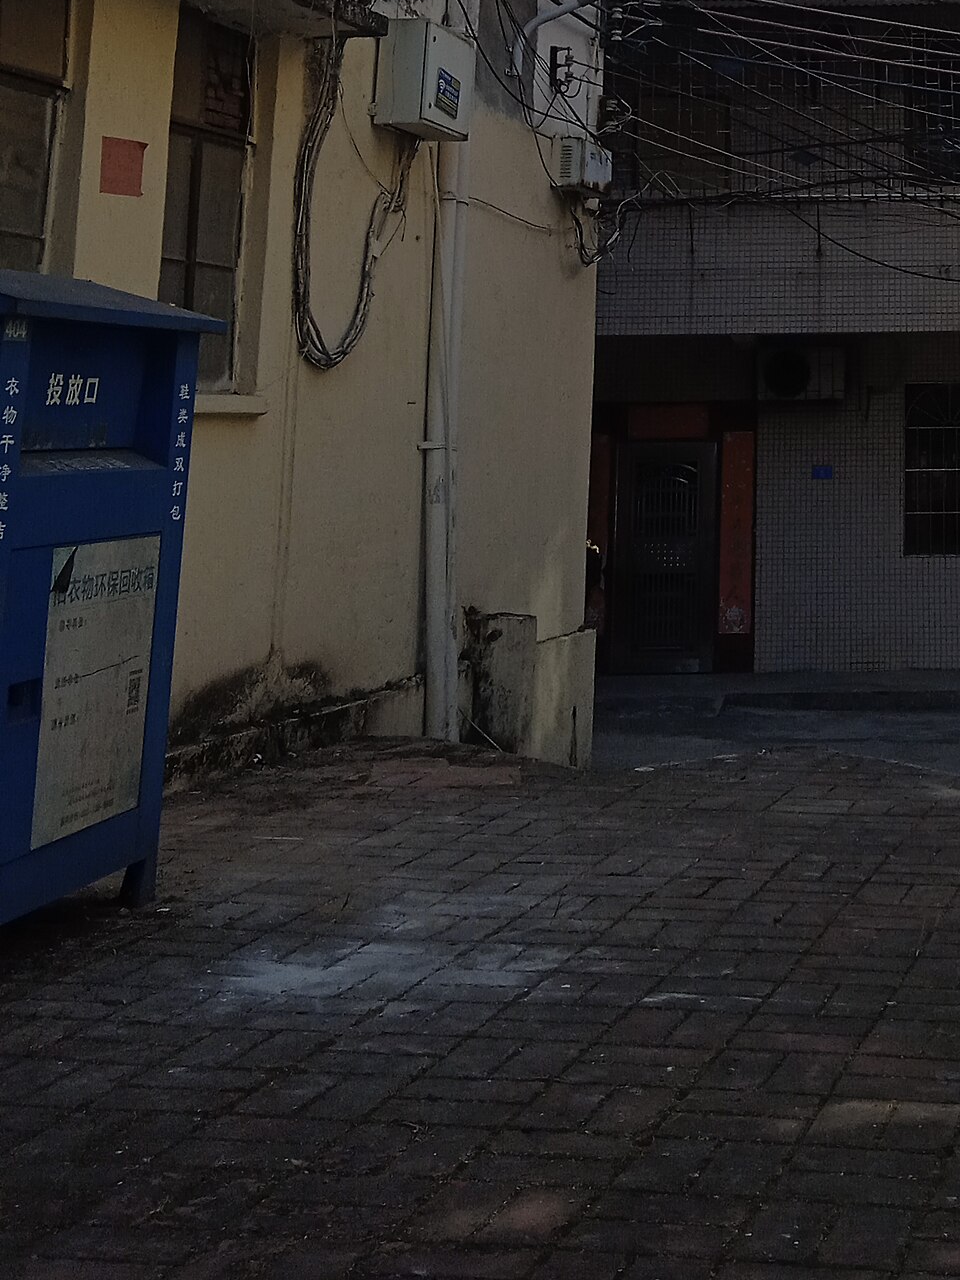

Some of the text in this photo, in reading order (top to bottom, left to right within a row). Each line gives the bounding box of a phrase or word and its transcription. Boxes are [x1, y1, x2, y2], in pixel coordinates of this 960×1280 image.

[45, 372, 100, 407] 投放口
[170, 383, 191, 521] 鞋类成双打包
